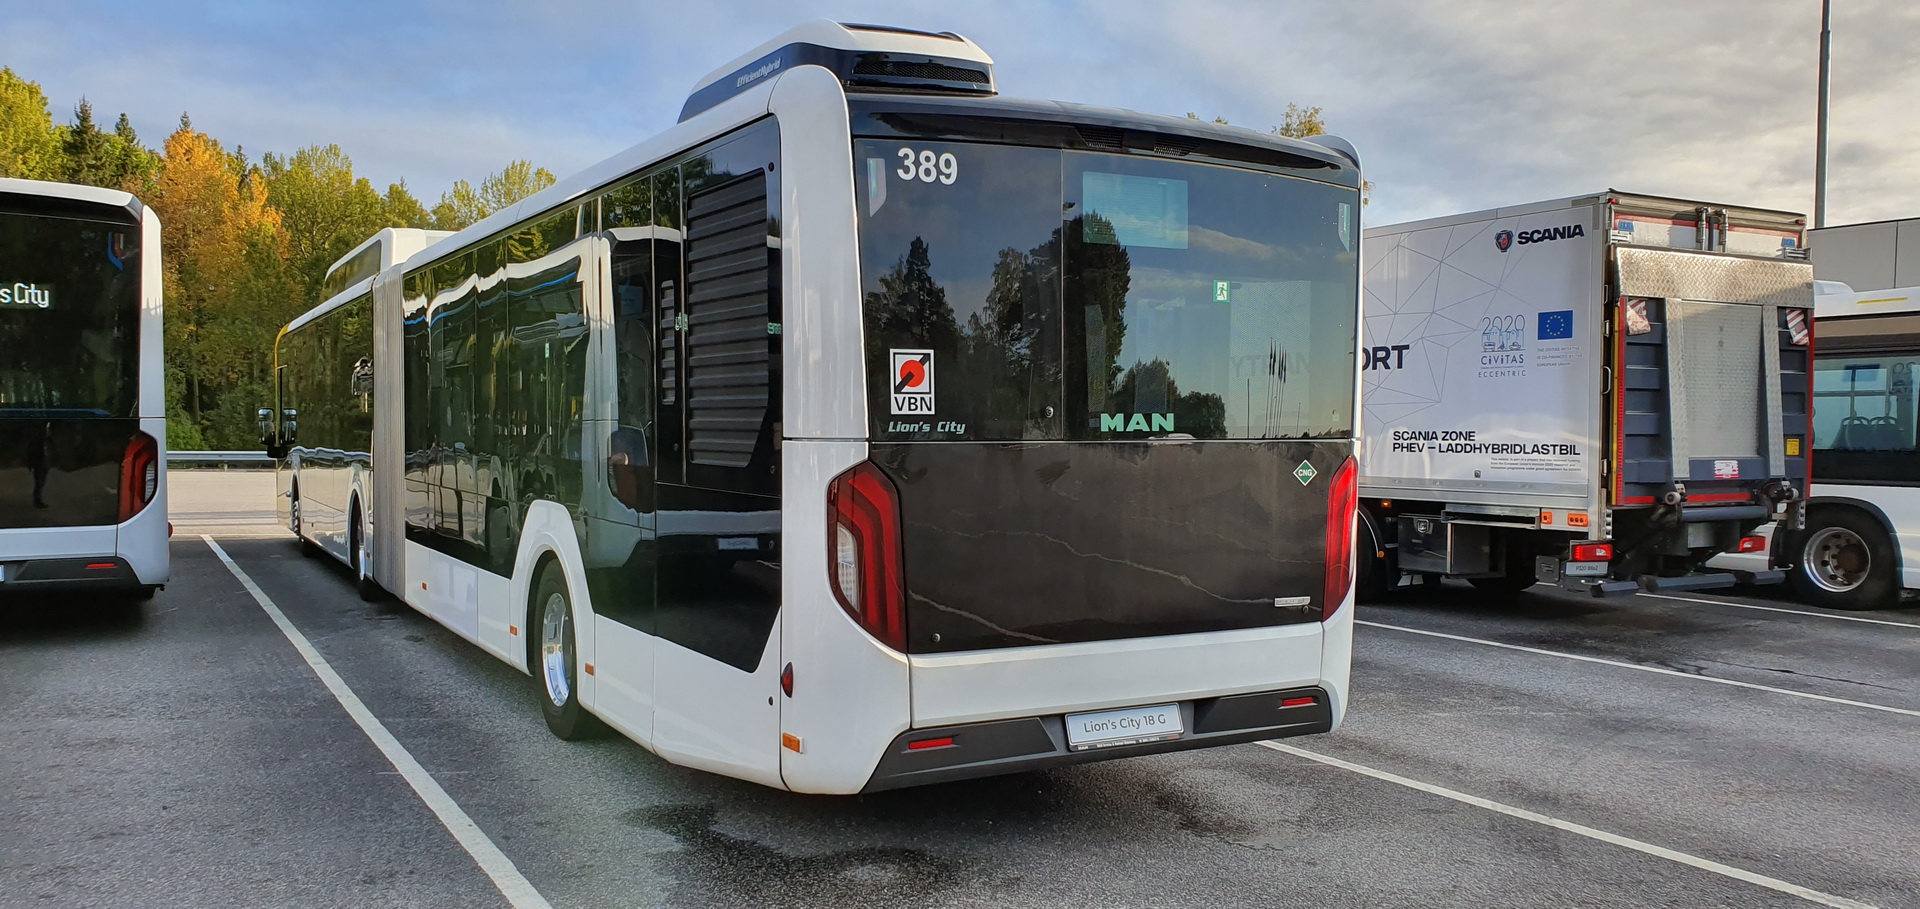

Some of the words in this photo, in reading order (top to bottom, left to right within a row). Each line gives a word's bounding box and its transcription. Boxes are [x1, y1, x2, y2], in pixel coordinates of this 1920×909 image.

[897, 147, 958, 185] 389
[1517, 224, 1585, 245] SCANIA
[13, 282, 49, 308] City
[1478, 369, 1527, 378] ECCENTRIC
[894, 396, 932, 412] VBN
[888, 421, 931, 433] Lion's
[936, 421, 966, 434] City
[1100, 413, 1174, 432] MAN
[1392, 430, 1439, 441] SCANIA
[1441, 430, 1476, 441] ZONE
[1392, 442, 1425, 453] PHEV
[1438, 443, 1581, 456] LADDHYBRIDLASTBIL
[1298, 469, 1313, 477] CNG
[1084, 719, 1117, 733] Lion's
[1119, 717, 1141, 730] City
[1143, 714, 1155, 725] 18
[1157, 714, 1166, 724] G
